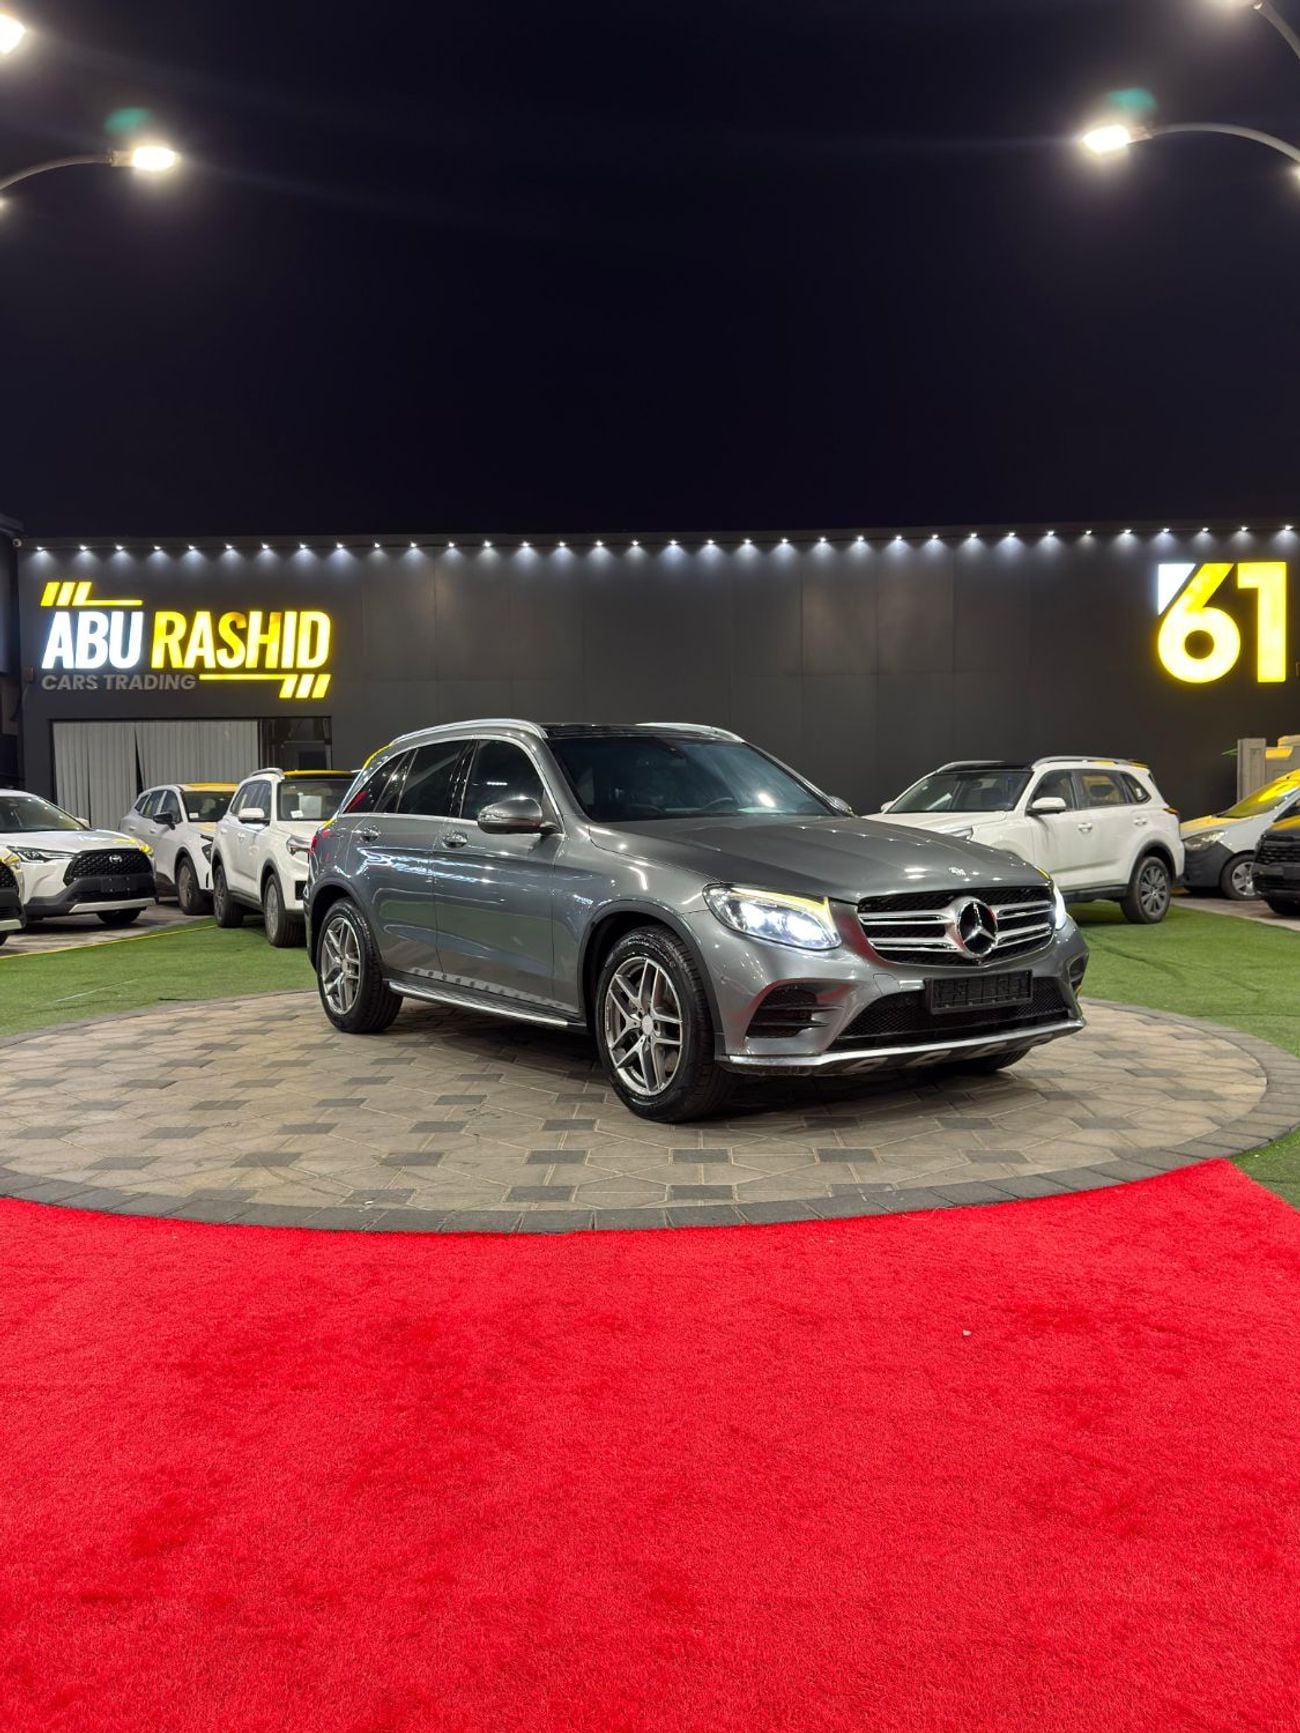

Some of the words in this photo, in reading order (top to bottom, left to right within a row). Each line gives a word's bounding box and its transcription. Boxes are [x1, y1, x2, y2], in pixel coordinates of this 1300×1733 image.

[41, 611, 144, 669] ABU
[151, 611, 331, 669] RASHID
[1157, 561, 1287, 683] 61
[41, 674, 98, 691] CARS
[103, 674, 196, 691] TRADING
